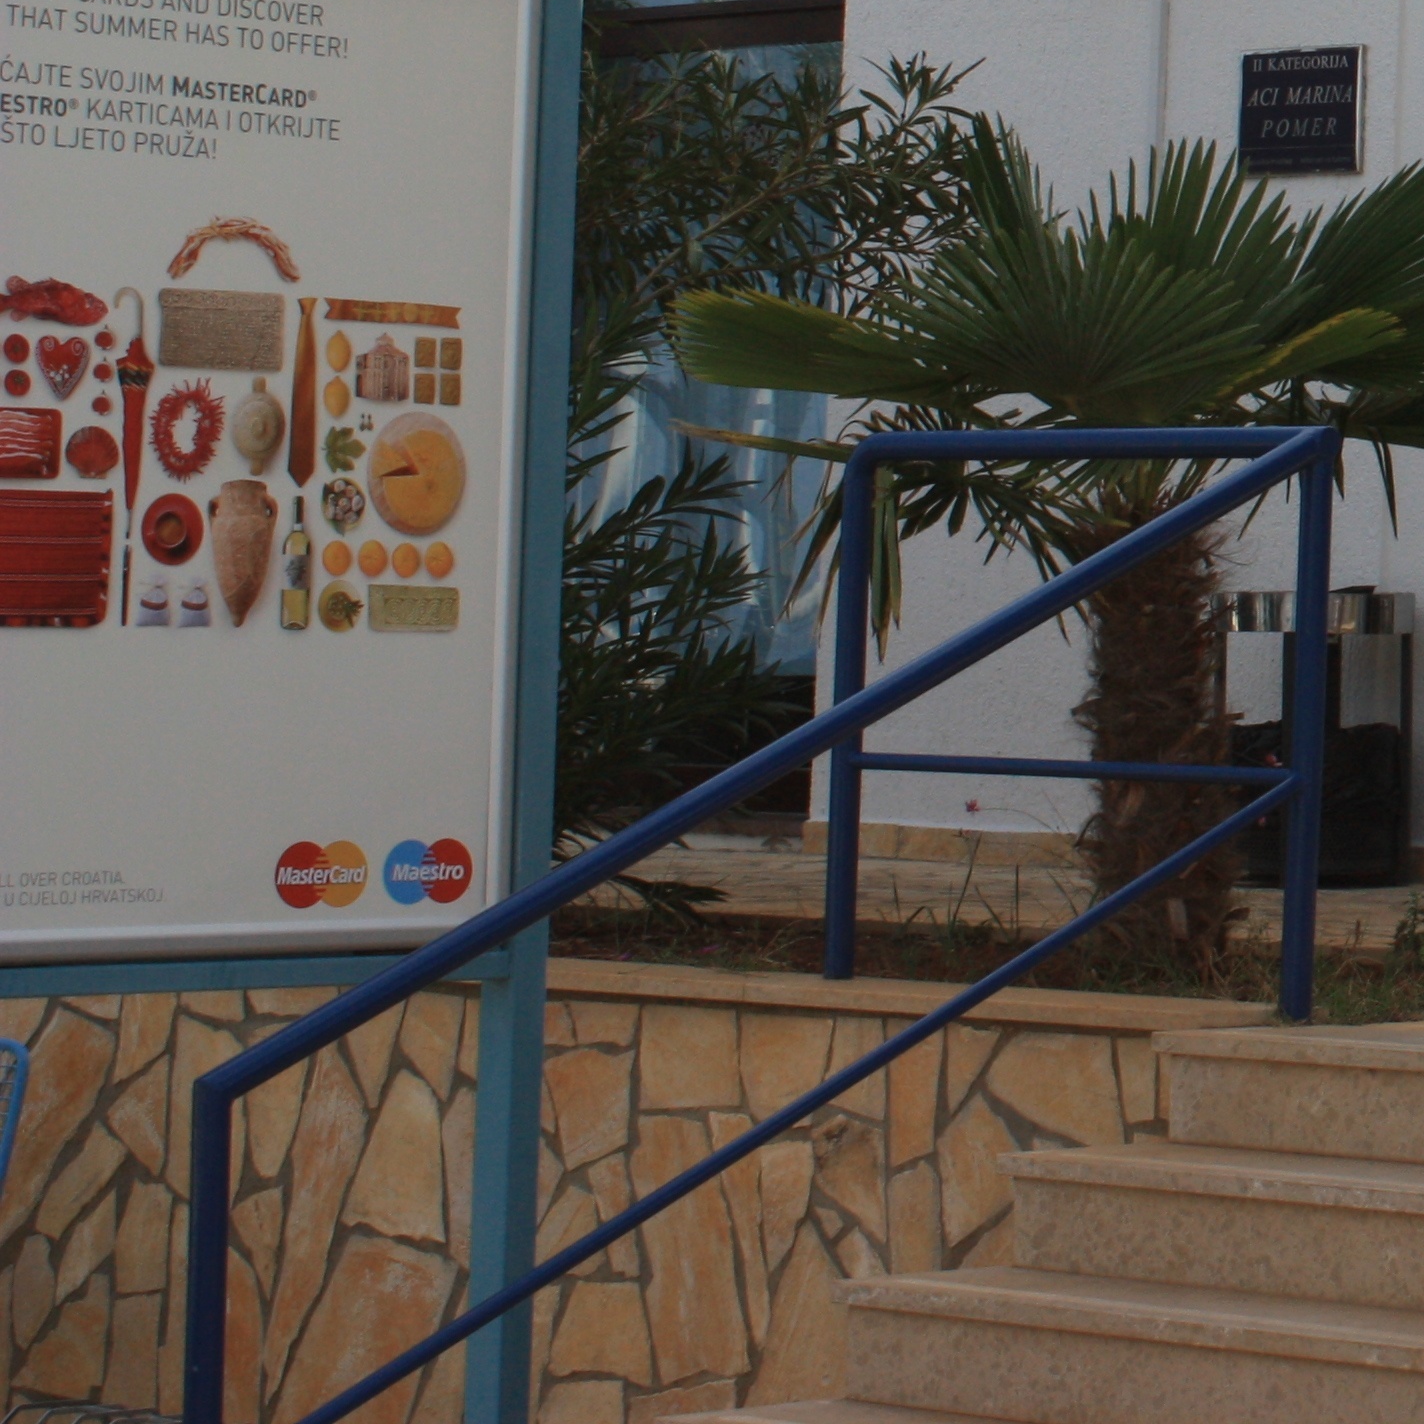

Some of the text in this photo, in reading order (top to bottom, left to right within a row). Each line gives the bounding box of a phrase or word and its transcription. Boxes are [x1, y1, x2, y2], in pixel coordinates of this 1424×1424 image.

[6, 4, 348, 59] THAT SUMMER HAS TO OFFER!
[1268, 55, 1349, 72] KATEGORIJA
[80, 67, 164, 96] SVOJIM
[1247, 84, 1353, 107] ACI MARINA
[87, 98, 219, 131] KARTICAMA
[226, 109, 231, 132] I
[239, 111, 341, 141] OTKRIJTE
[1260, 117, 1338, 138] POMER
[0, 114, 217, 160] ŠTO LJETO PRUŽA!
[20, 871, 58, 887] OVER
[276, 862, 465, 885] MasterCard Maestro
[19, 890, 77, 906] CIJELOJ
